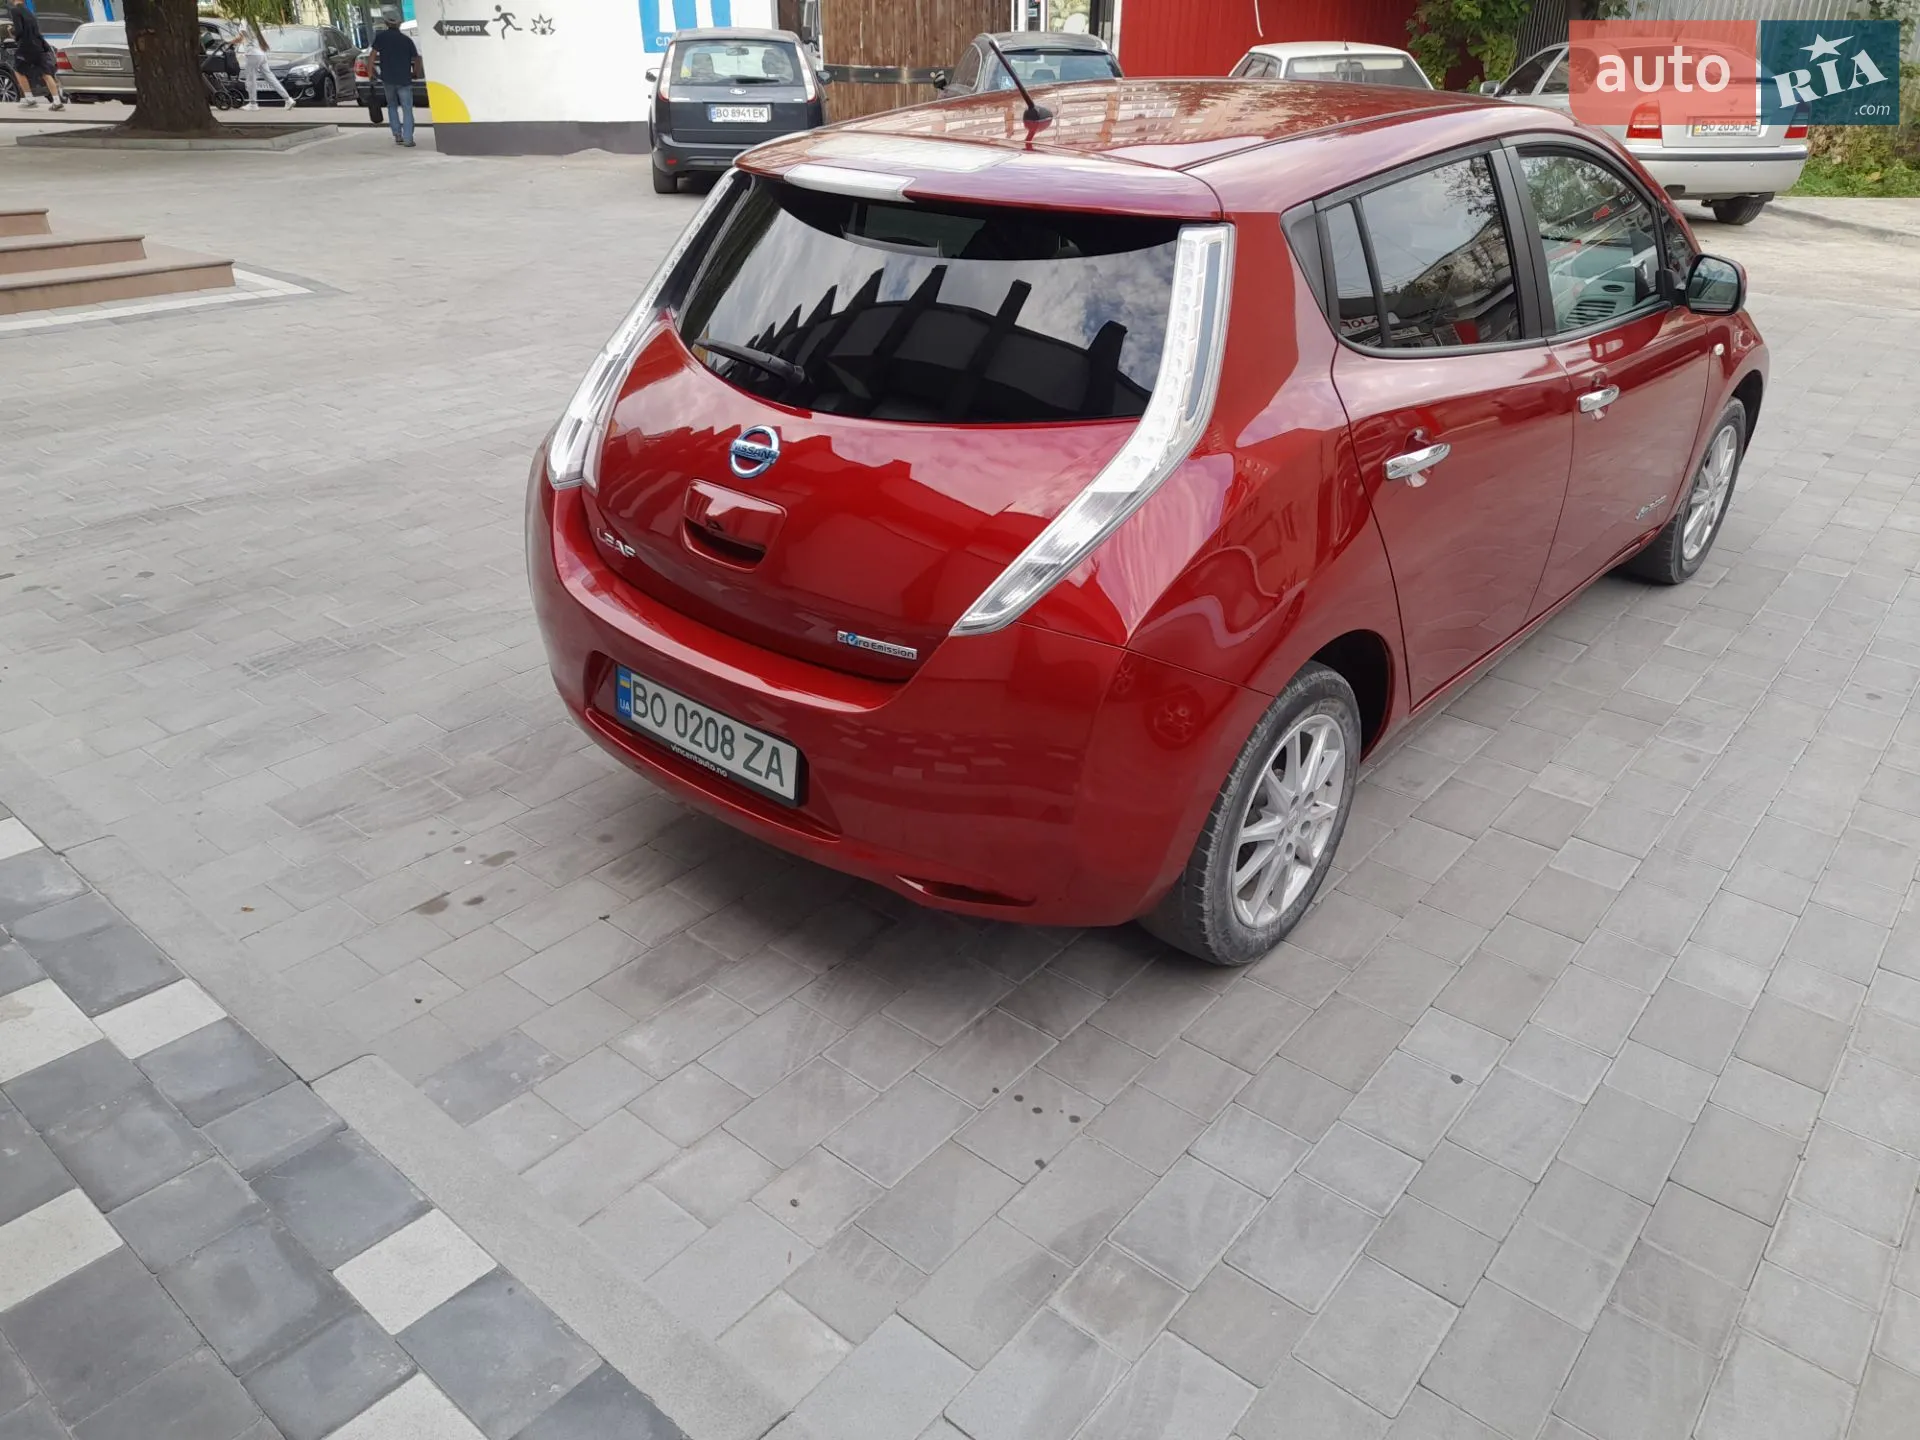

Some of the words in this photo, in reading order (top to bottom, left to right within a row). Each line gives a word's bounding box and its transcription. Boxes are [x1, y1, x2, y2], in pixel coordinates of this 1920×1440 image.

[442, 24, 481, 34] Укриття
[716, 110, 729, 118] BO
[731, 110, 751, 118] 8941
[753, 110, 765, 118] EK
[733, 444, 771, 460] NISSAN
[596, 527, 637, 558] LEAF
[619, 699, 631, 713] UA
[632, 679, 667, 729] BO
[674, 702, 735, 762] 0208
[742, 732, 785, 789] ZA
